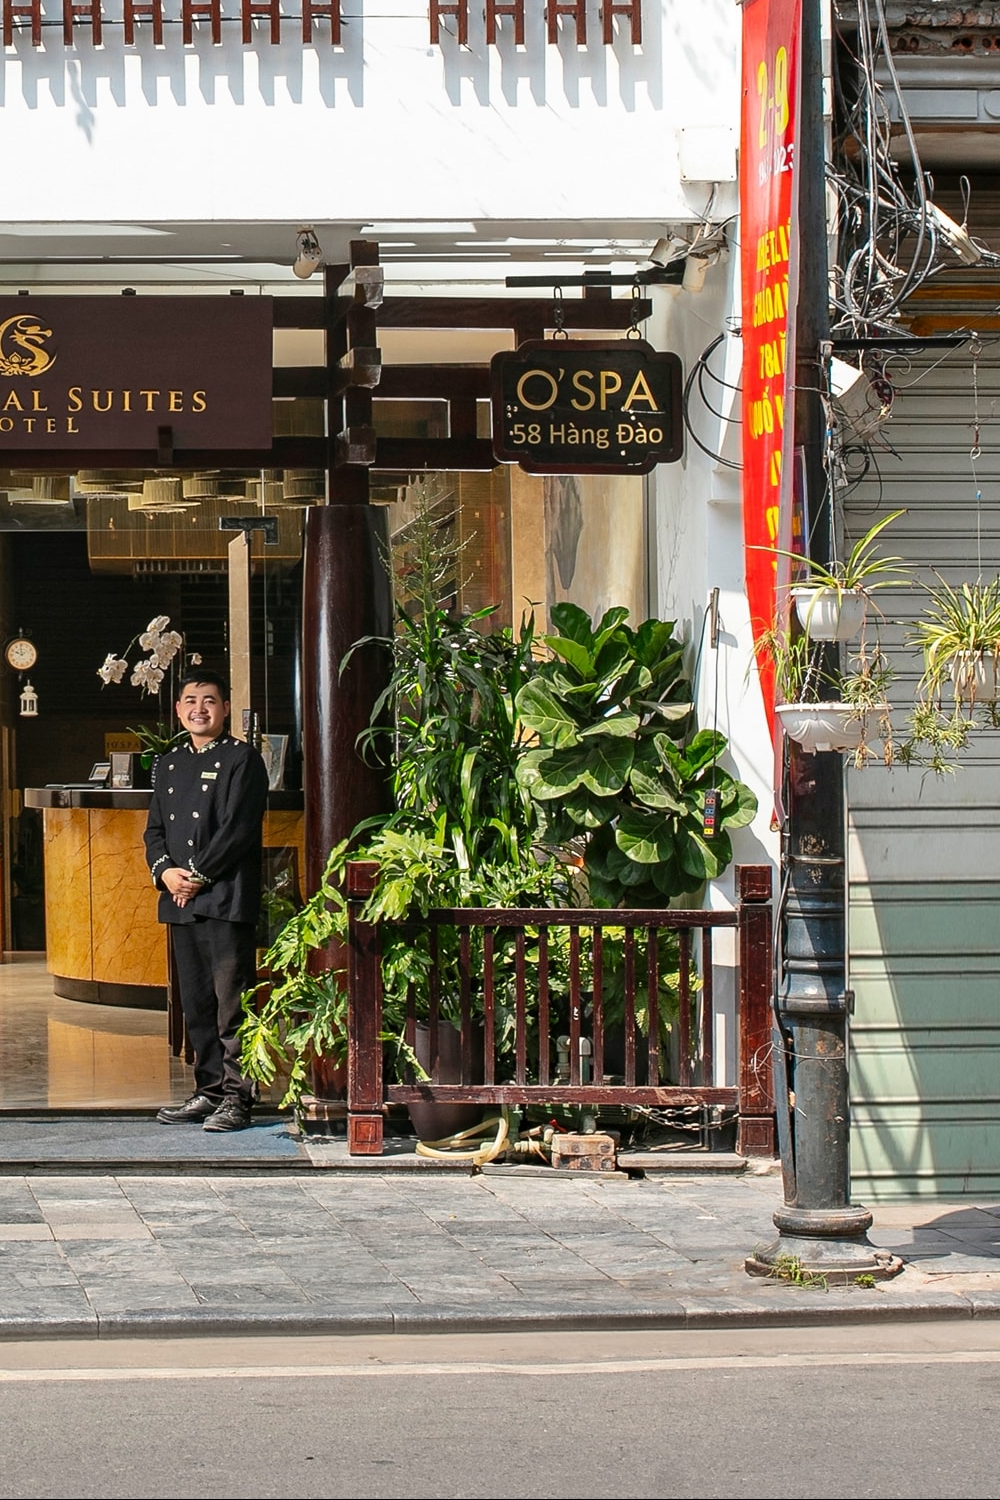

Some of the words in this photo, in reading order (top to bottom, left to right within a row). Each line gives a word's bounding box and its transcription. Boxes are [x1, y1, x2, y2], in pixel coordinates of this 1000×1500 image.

[757, 45, 789, 150] 2-9
[67, 386, 207, 413] SUITES
[516, 368, 658, 411] O'SPA
[512, 424, 541, 444] 58
[550, 422, 610, 449] Hàng
[616, 422, 663, 444] Đào
